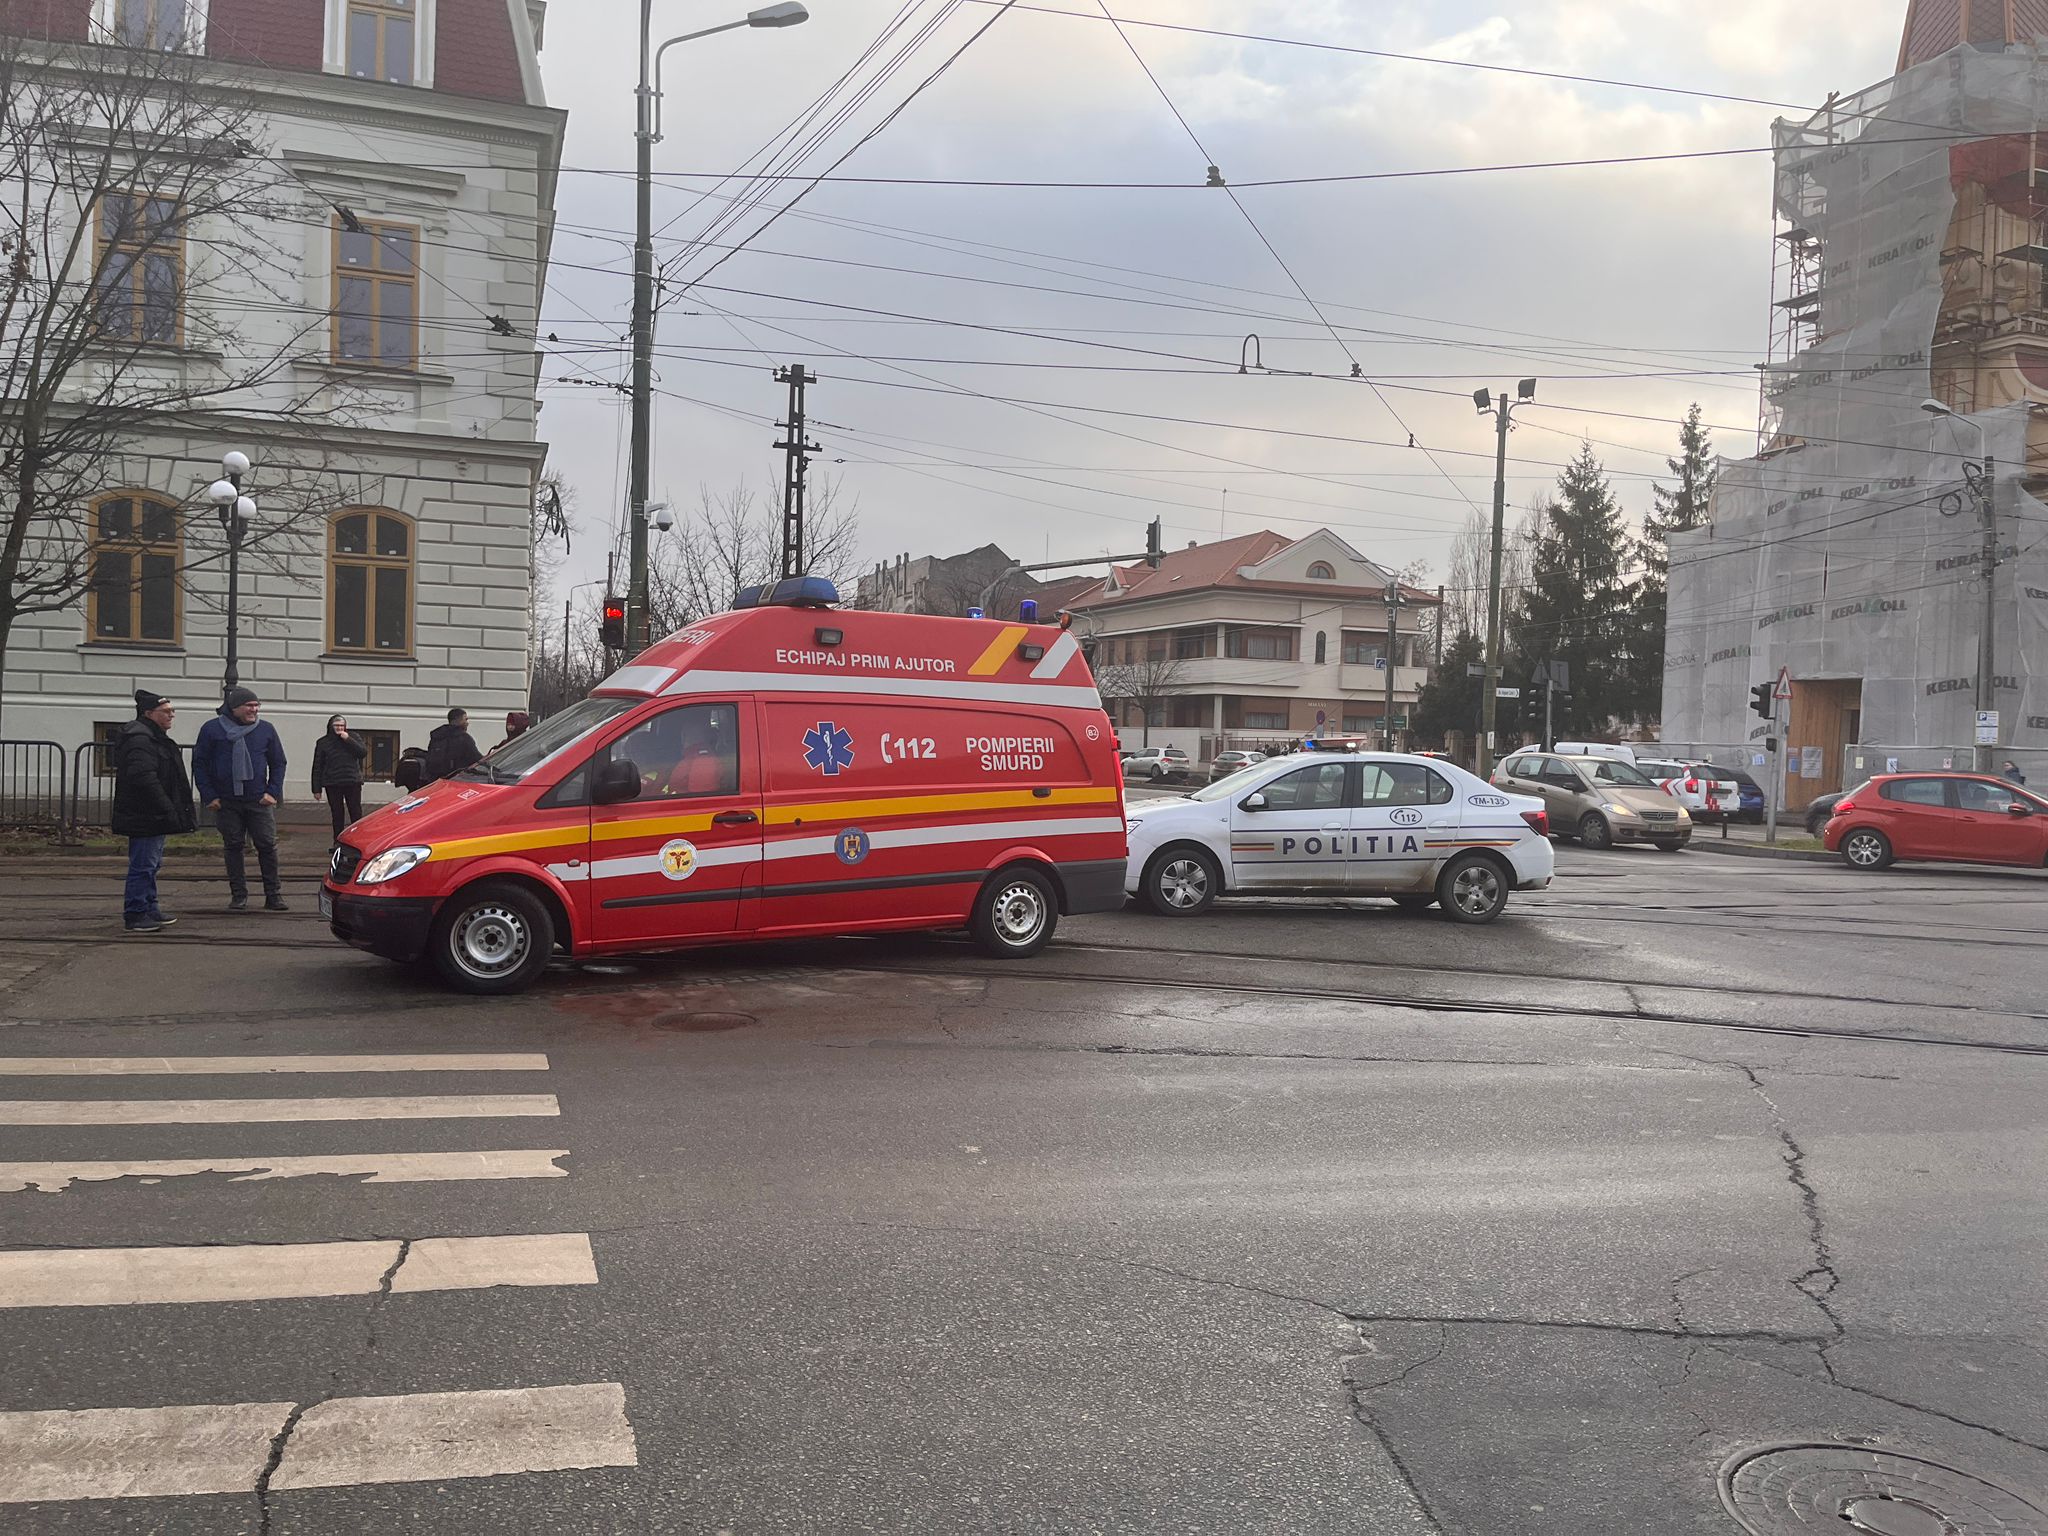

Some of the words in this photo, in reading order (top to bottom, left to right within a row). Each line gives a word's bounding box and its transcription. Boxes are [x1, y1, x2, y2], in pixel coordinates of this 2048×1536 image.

[776, 649, 846, 668] ECHIPAJ
[851, 653, 891, 670] PRIM
[895, 656, 956, 673] AJUTOR
[1926, 676, 2018, 696] KERAOLL
[1087, 727, 1099, 738] B2
[894, 738, 937, 760] 112
[966, 736, 1055, 754] POMPIERII
[981, 754, 1044, 772] SMURD
[1473, 796, 1504, 806] TM-135
[1400, 813, 1417, 824] 112
[1282, 835, 1419, 855] POLITIA
